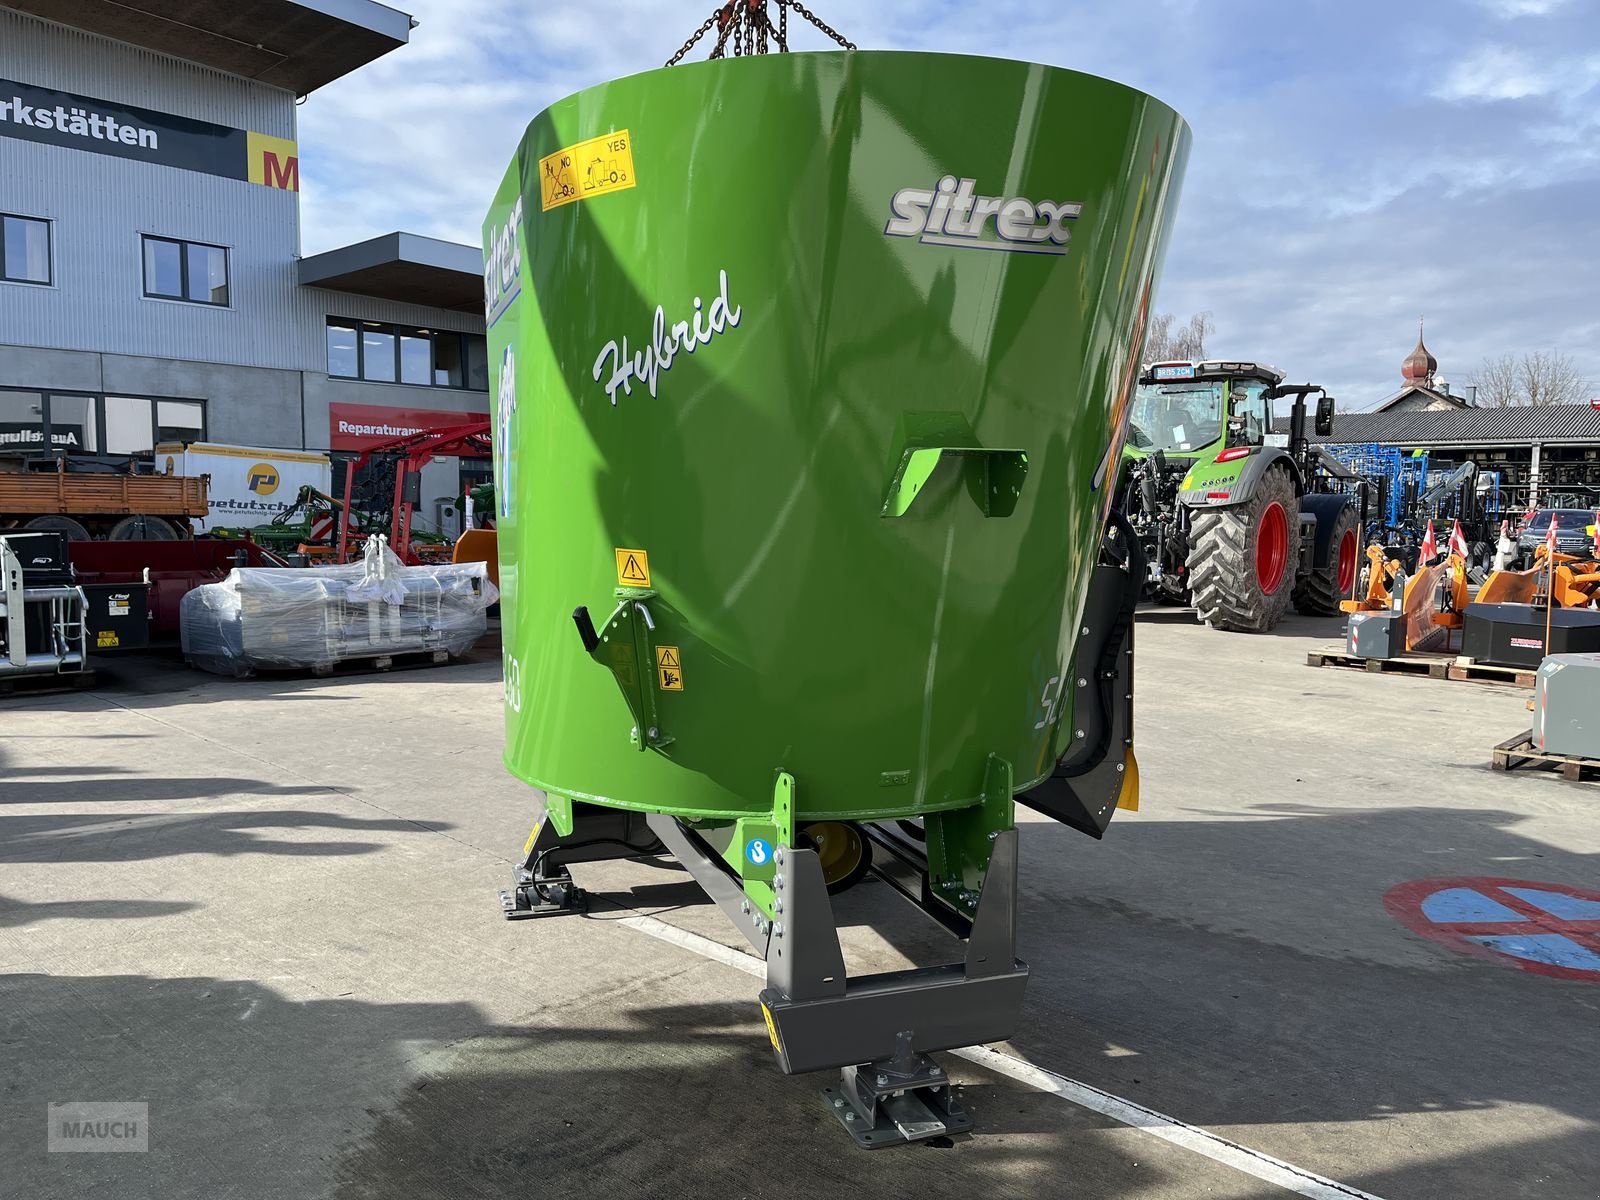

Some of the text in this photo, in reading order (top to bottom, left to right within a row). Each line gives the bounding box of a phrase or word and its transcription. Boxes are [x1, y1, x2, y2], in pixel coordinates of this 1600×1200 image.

[560, 156, 571, 169] NO
[607, 139, 627, 153] YES
[884, 174, 1083, 245] sitrex
[592, 269, 742, 407] Hybrid
